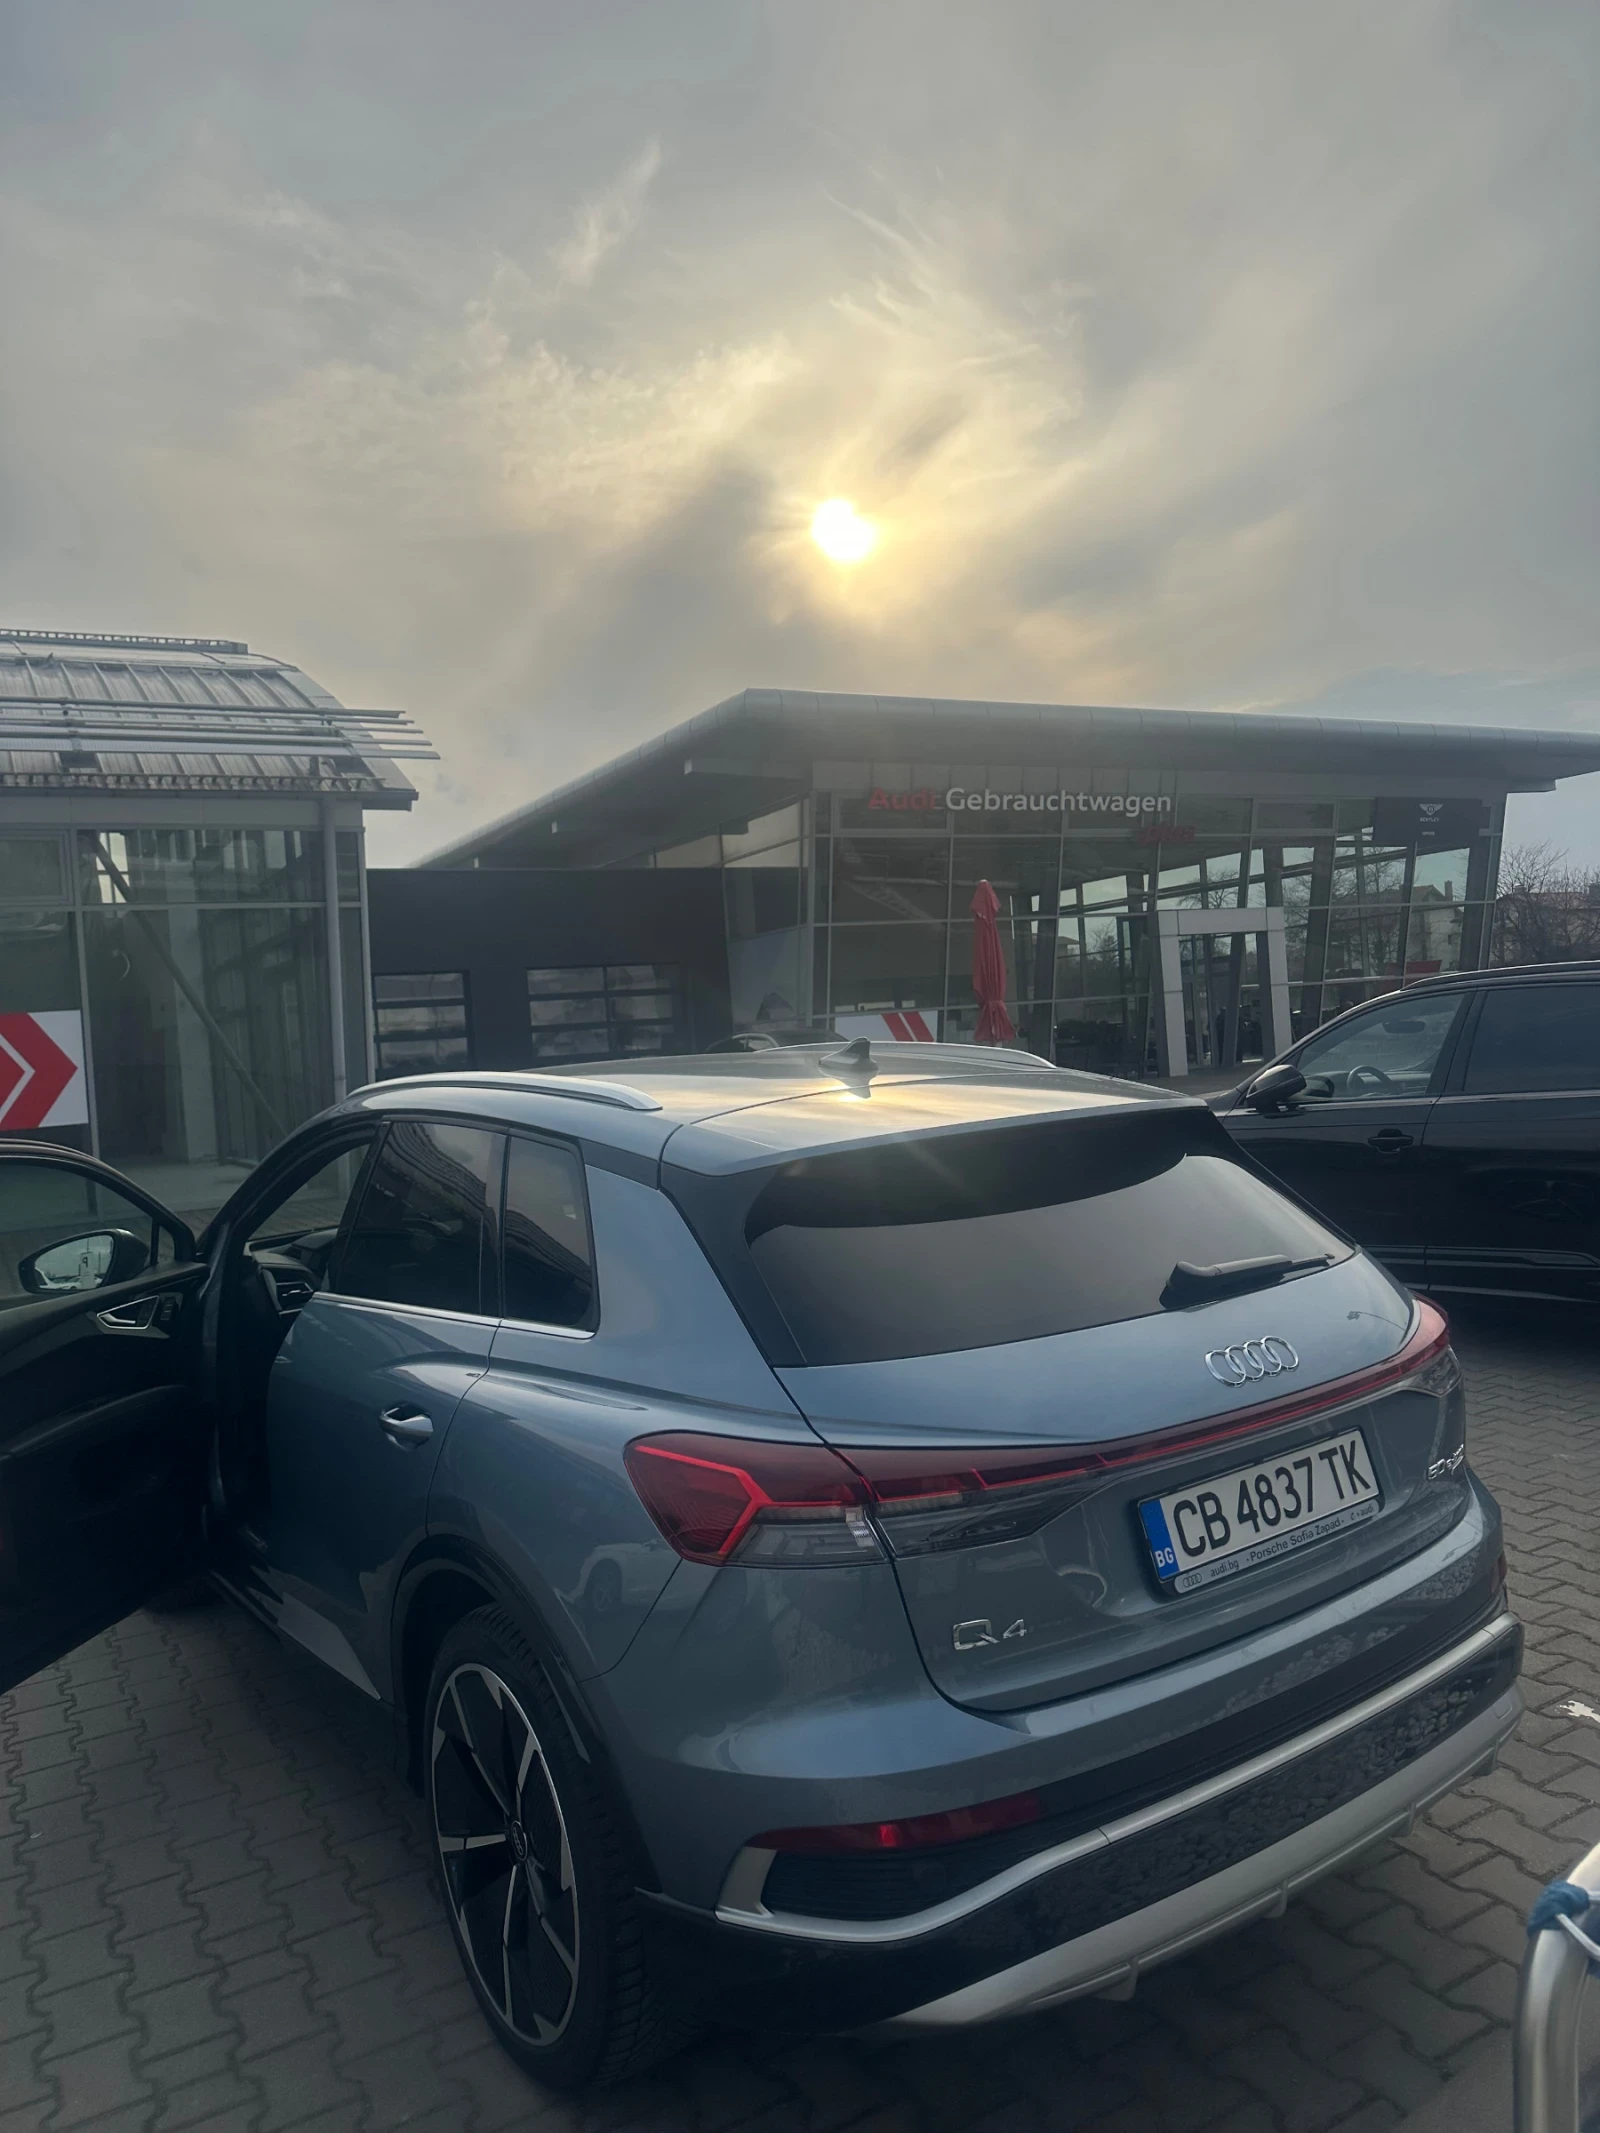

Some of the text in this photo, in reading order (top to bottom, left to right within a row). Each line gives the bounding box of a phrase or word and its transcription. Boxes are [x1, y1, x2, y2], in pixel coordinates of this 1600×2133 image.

[868, 787, 1172, 818] Audi Gebrauchtwagen
[1173, 1491, 1231, 1557] CB
[1237, 1456, 1313, 1533] 4837
[1319, 1439, 1371, 1500] TK
[1154, 1547, 1175, 1568] BG
[1210, 1560, 1240, 1577] audi.bg
[1250, 1540, 1289, 1562] Porsche
[1290, 1530, 1314, 1546] Sofia
[1315, 1518, 1341, 1536] Zapad
[952, 1618, 1028, 1650] Q4
